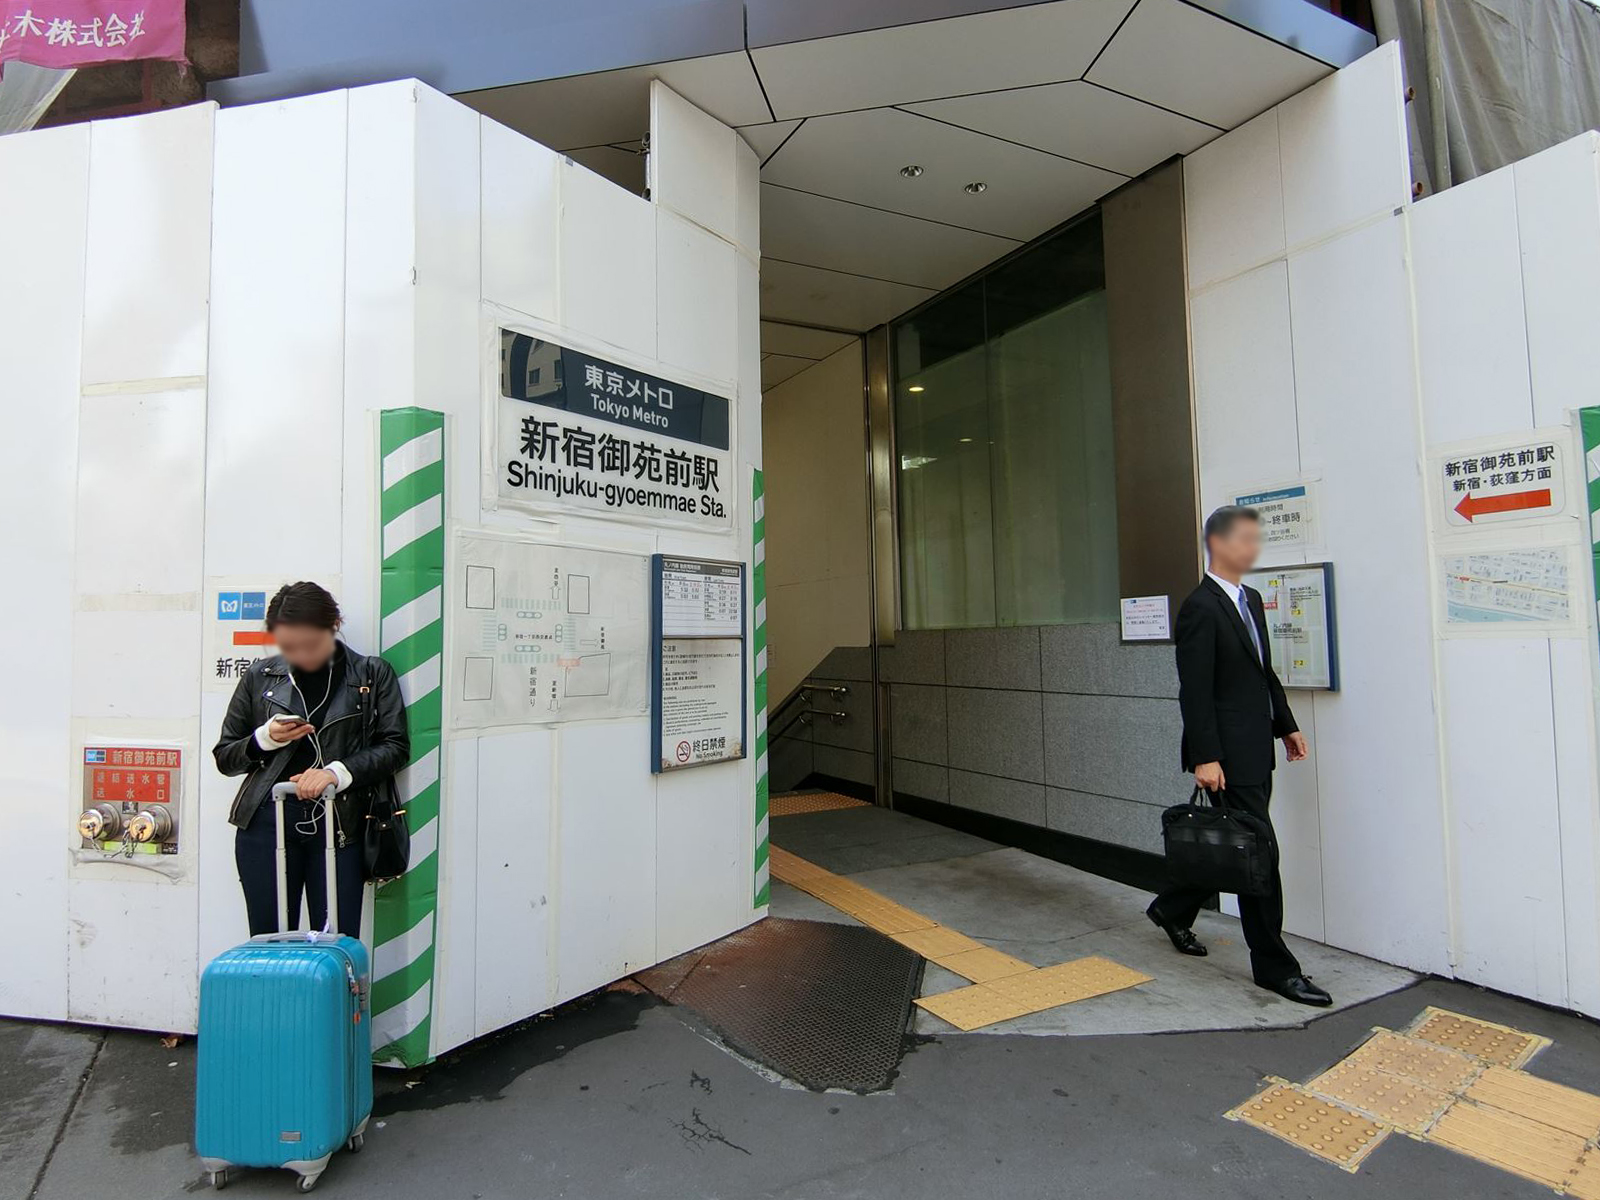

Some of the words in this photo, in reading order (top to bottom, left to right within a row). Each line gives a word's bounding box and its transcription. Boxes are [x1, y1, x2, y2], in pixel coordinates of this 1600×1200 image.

[585, 364, 674, 410] 東京メトロ
[590, 393, 630, 420] Tokyo
[632, 405, 669, 428] Metro
[520, 416, 720, 493] 新宿御苑前駅
[1445, 445, 1556, 477] 新宿御苑前駅
[507, 460, 697, 514] Shinjuku-gyoemmae
[700, 494, 728, 519] Sta.
[1453, 466, 1552, 492] 新宿・荻窪方面
[216, 657, 260, 678] 新宿
[112, 750, 178, 766] 新宿御苑前駅
[693, 736, 726, 752] 終日禁煙
